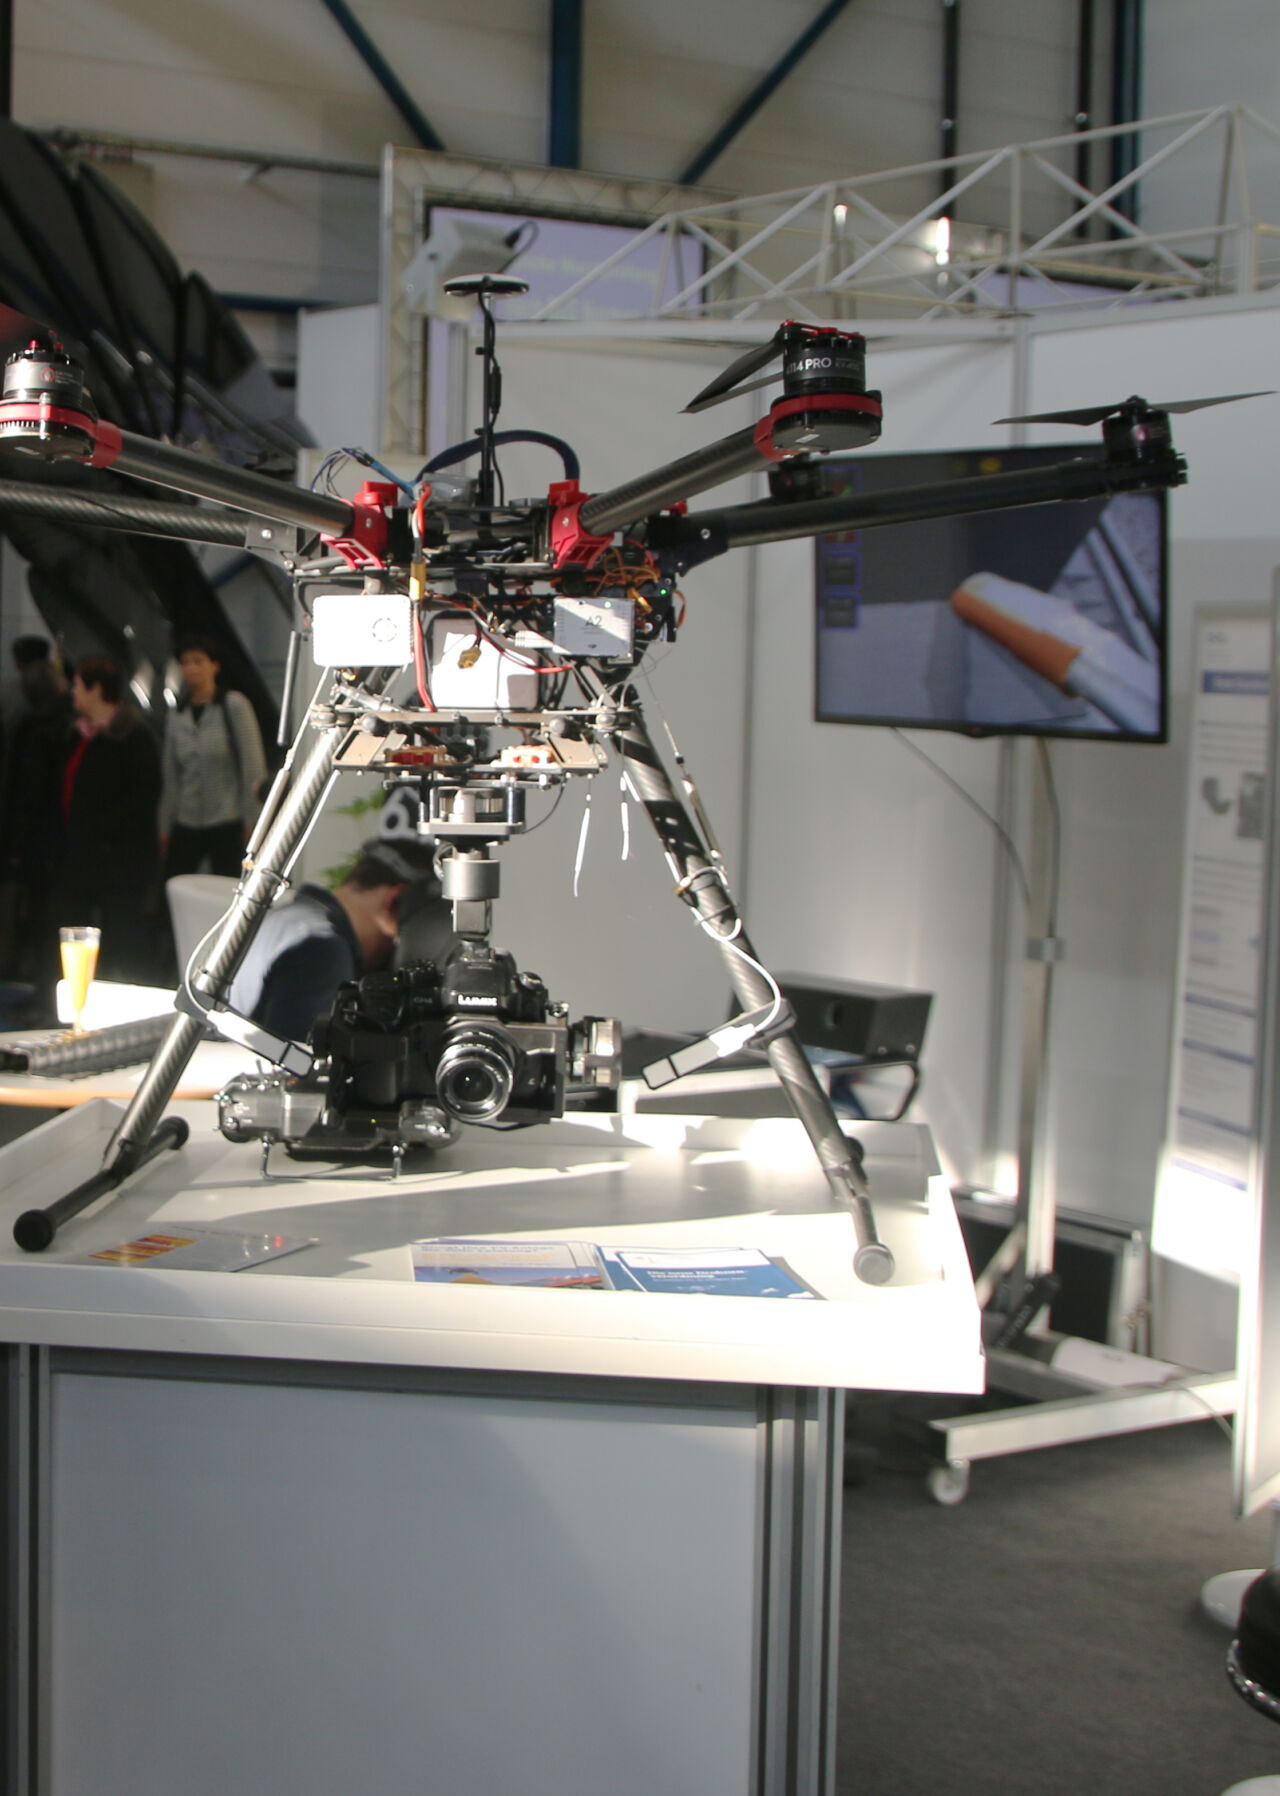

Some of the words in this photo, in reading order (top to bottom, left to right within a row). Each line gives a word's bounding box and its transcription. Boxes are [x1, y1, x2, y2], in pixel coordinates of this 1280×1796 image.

[805, 357, 832, 370] PRO
[585, 615, 602, 627] A2
[458, 994, 497, 1006] LUMIX
